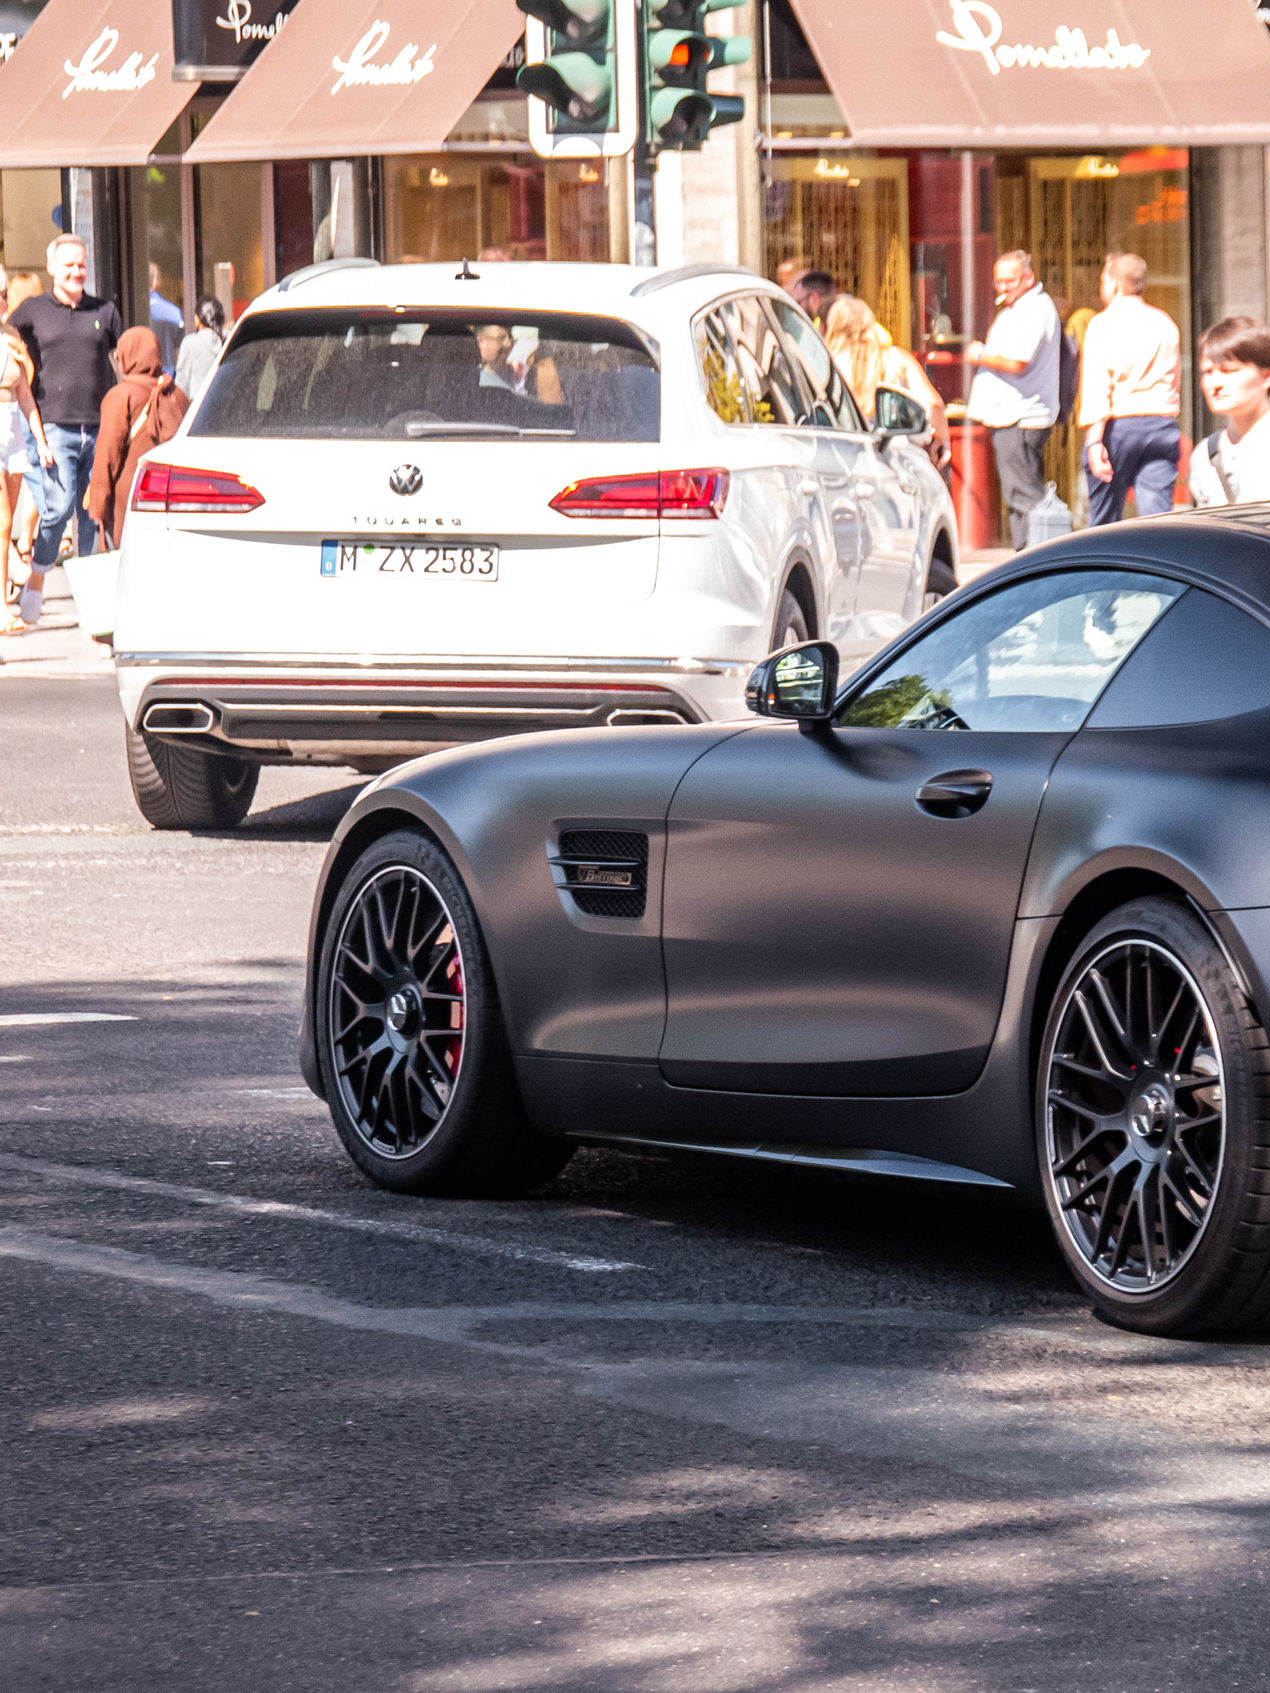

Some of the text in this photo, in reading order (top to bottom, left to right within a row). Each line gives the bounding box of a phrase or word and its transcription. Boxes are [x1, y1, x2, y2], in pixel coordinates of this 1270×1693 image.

[216, 0, 290, 44] Pomell
[937, 0, 1151, 75] Pomellato
[353, 516, 462, 526] TOUAREG
[341, 545, 357, 571] M
[379, 546, 415, 573] ZX
[423, 547, 494, 575] 2583
